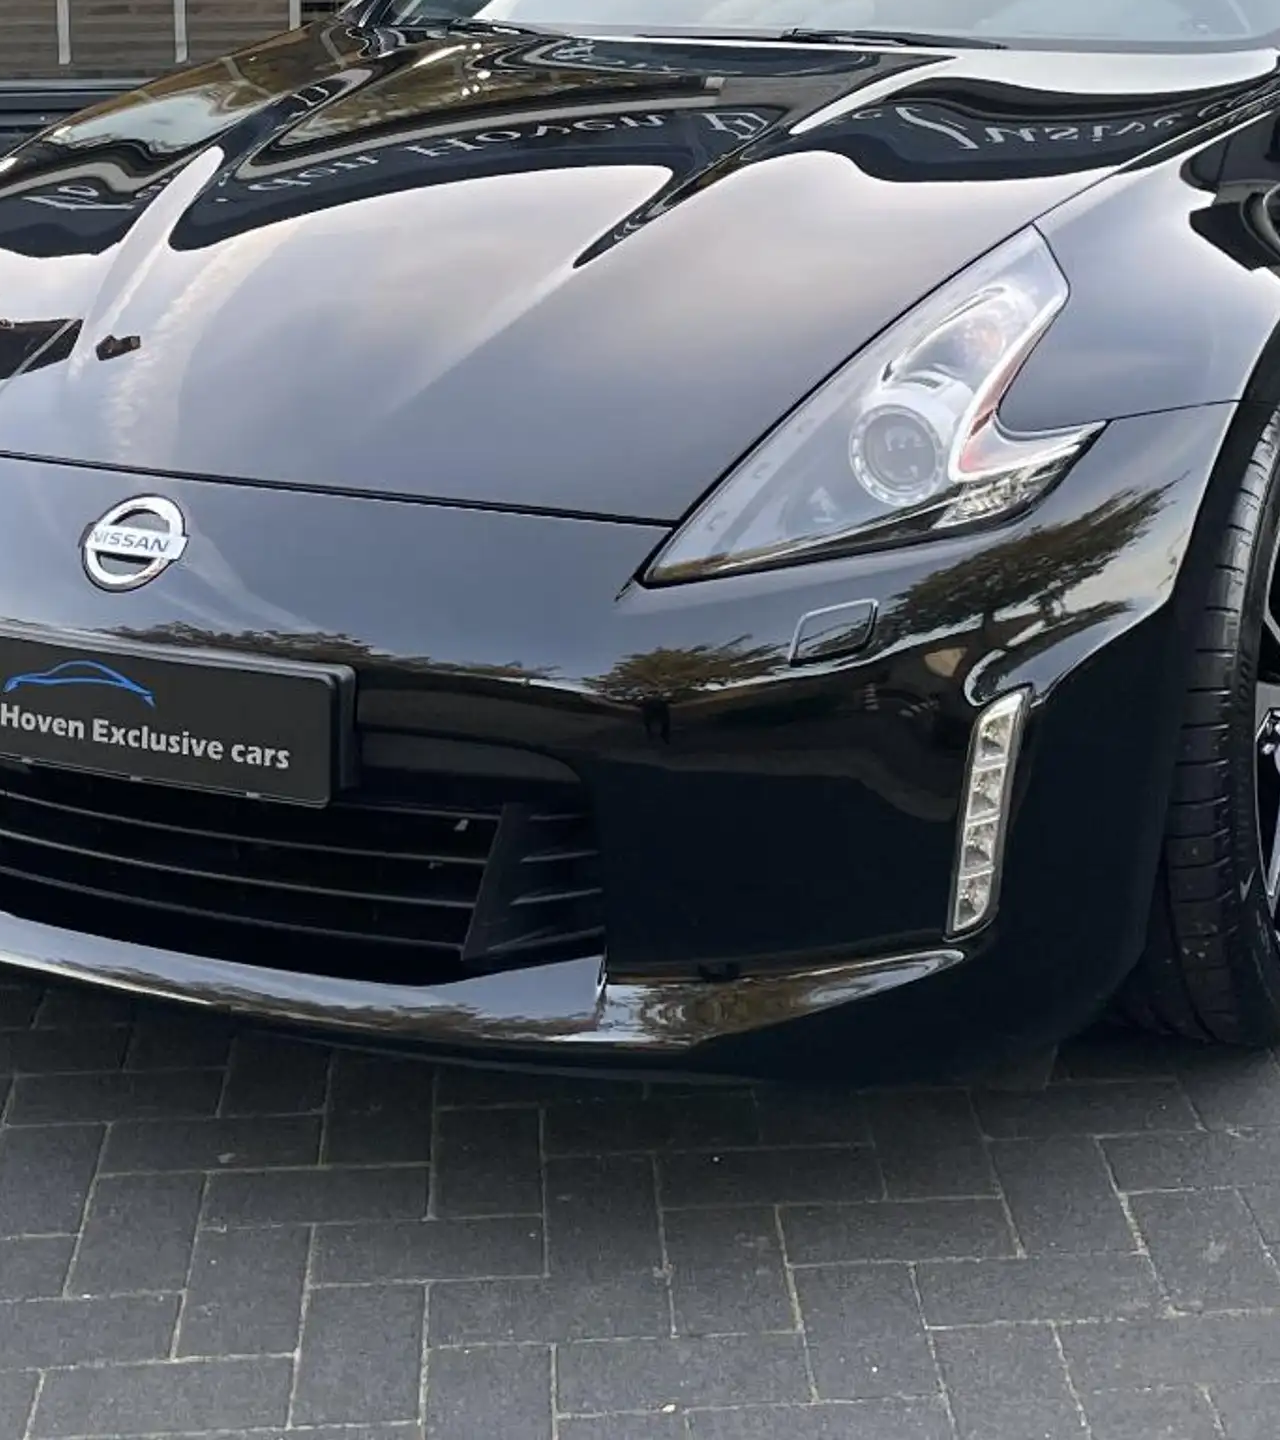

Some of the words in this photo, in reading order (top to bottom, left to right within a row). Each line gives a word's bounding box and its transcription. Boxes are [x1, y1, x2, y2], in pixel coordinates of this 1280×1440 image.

[89, 530, 171, 553] NISSAN
[0, 703, 86, 741] Hoven
[92, 718, 224, 761] Exclusive
[231, 740, 291, 770] cars
